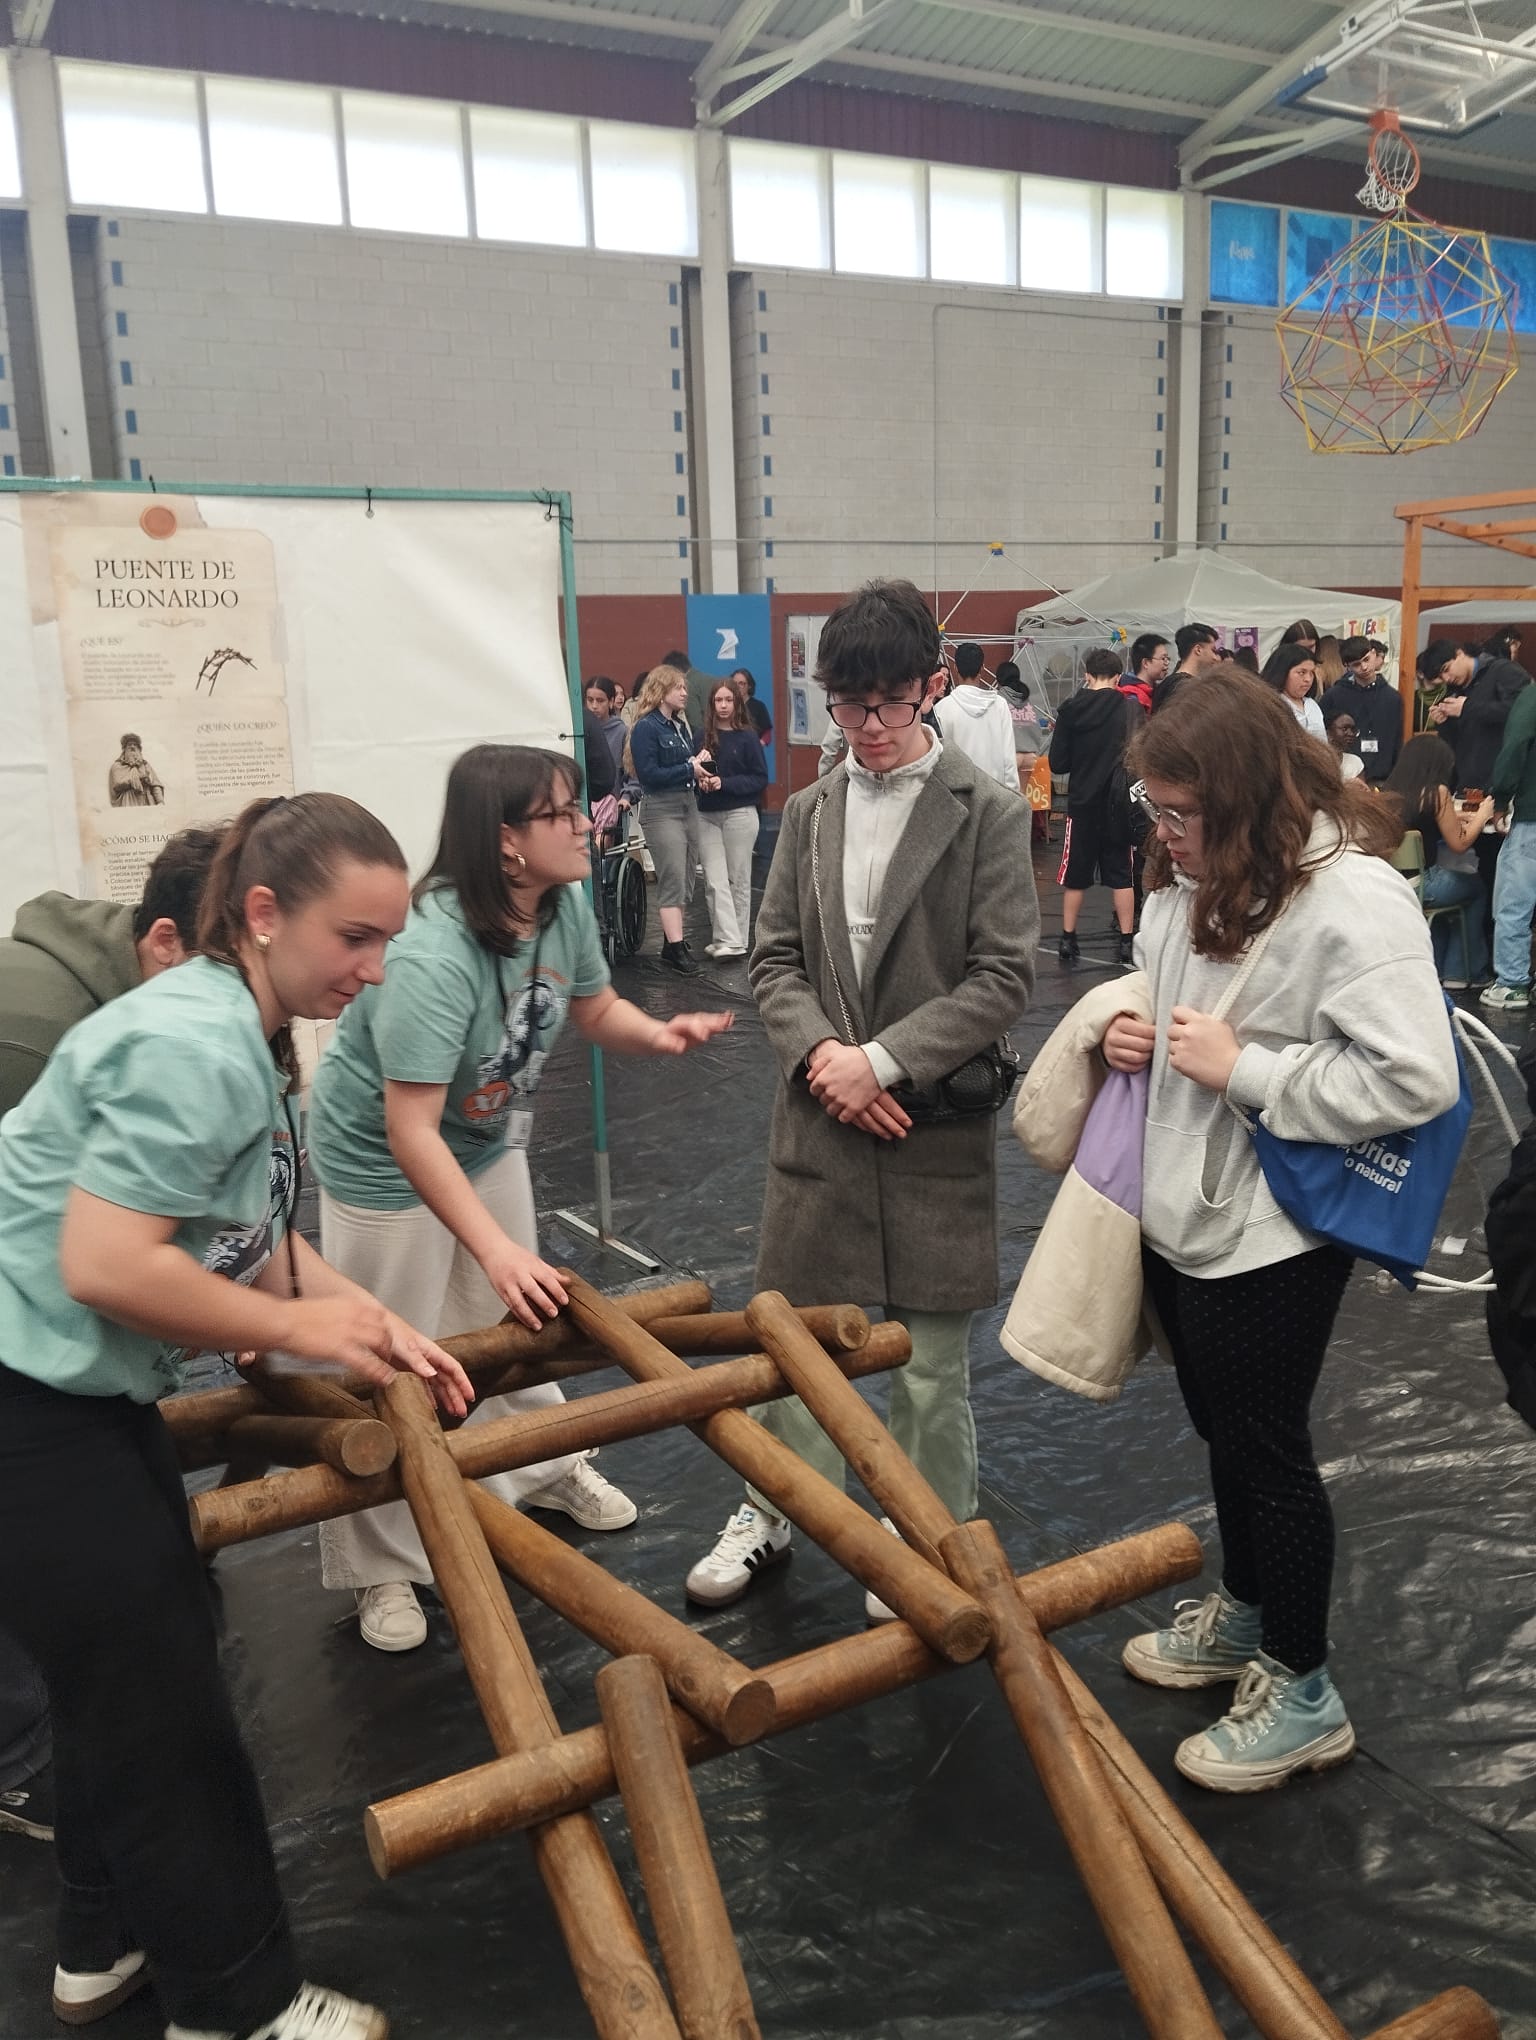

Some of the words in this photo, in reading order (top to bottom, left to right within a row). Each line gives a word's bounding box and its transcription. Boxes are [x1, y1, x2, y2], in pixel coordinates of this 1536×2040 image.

[95, 560, 195, 580] PUENTE
[201, 560, 236, 580] DE
[96, 588, 239, 609] LEONARDO
[100, 835, 137, 847] ¿CÓMO
[139, 834, 150, 843] SE
[1354, 1161, 1404, 1194] natural
